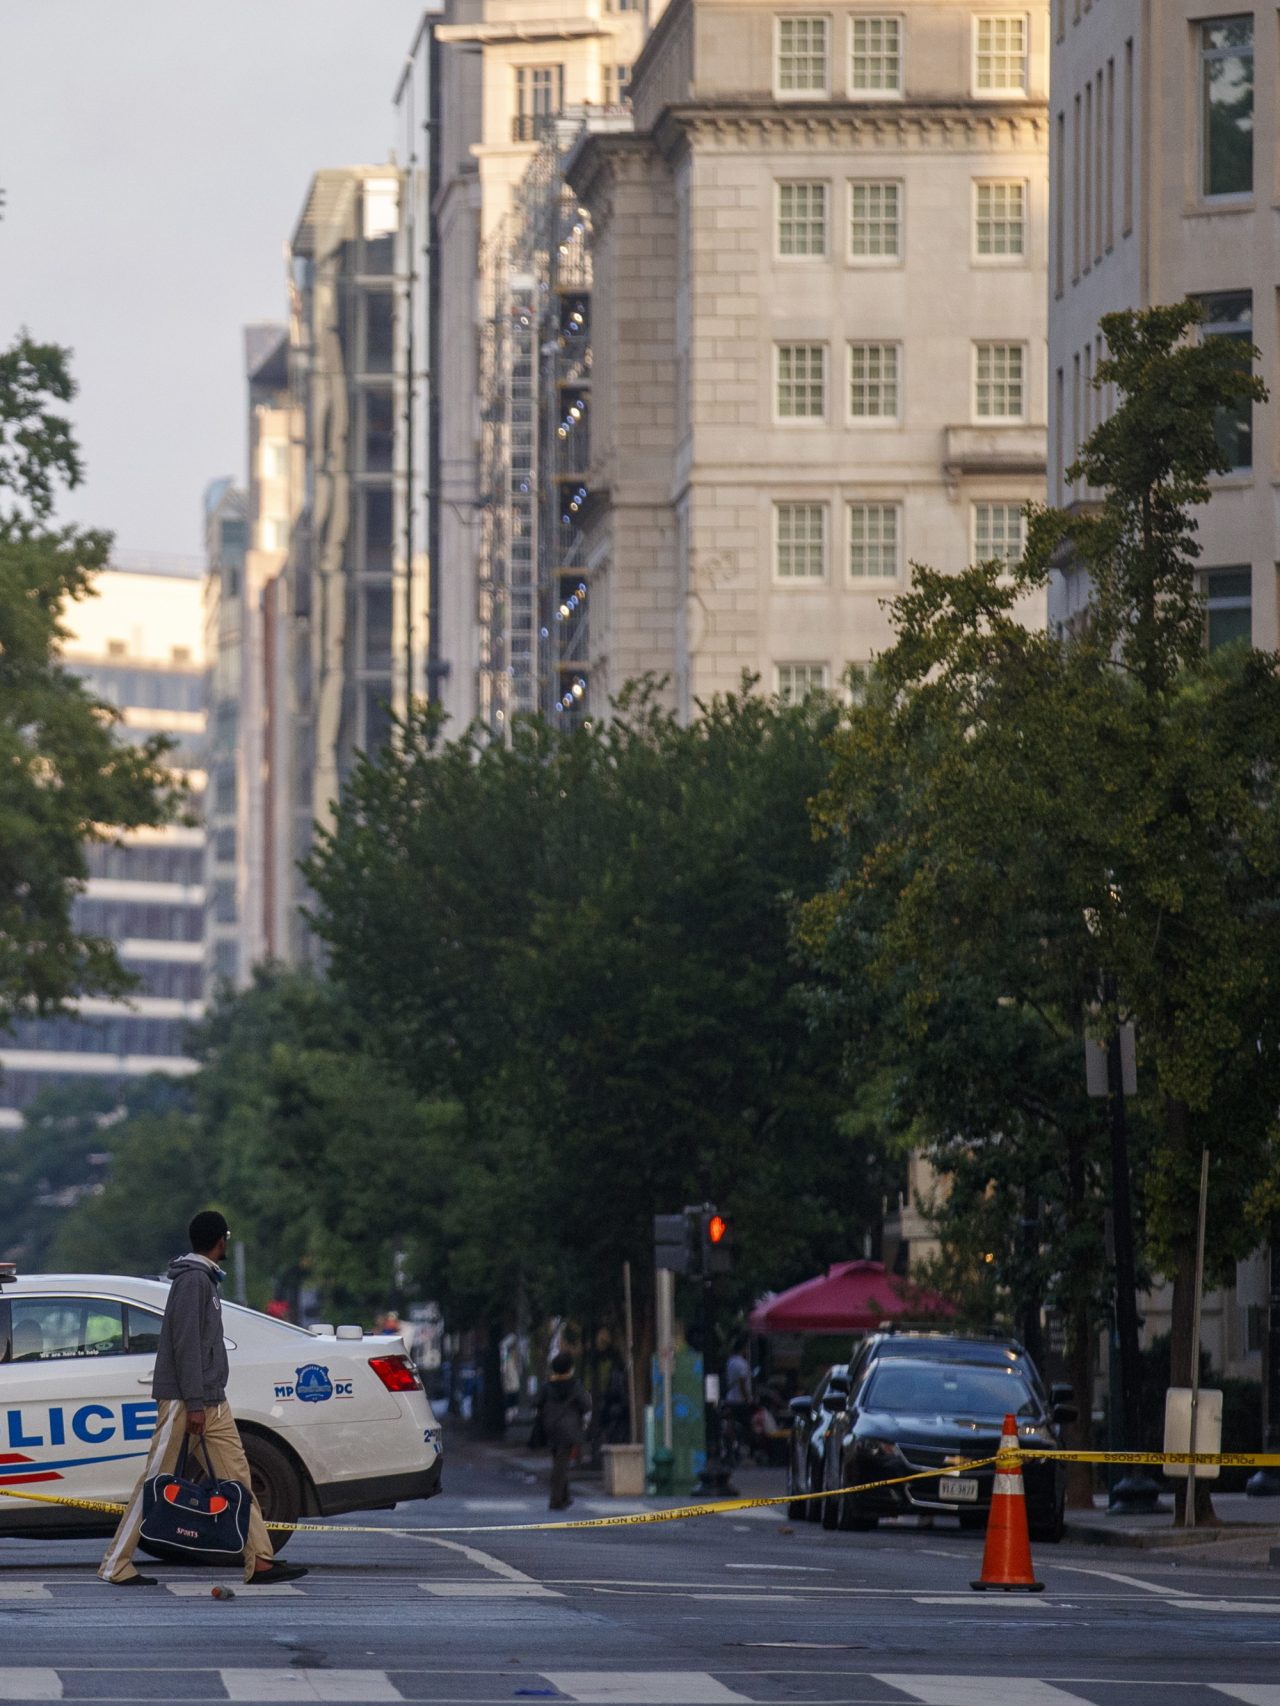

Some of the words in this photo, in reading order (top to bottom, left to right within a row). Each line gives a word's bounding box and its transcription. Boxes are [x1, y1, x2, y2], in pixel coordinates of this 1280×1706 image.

[274, 1386, 294, 1397] MP
[335, 1383, 353, 1394] DC
[1104, 1453, 1142, 1462] CROSS
[1145, 1454, 1167, 1463] NOT
[1170, 1454, 1185, 1464] DO
[1188, 1454, 1213, 1464] LINE
[1215, 1454, 1255, 1465] POLICE
[649, 1511, 674, 1522] LINE
[675, 1508, 715, 1519] POLICE
[566, 1519, 603, 1527] CROSS
[606, 1517, 628, 1525] NOT
[631, 1515, 647, 1523] DO
[176, 1527, 199, 1538] SPORTS
